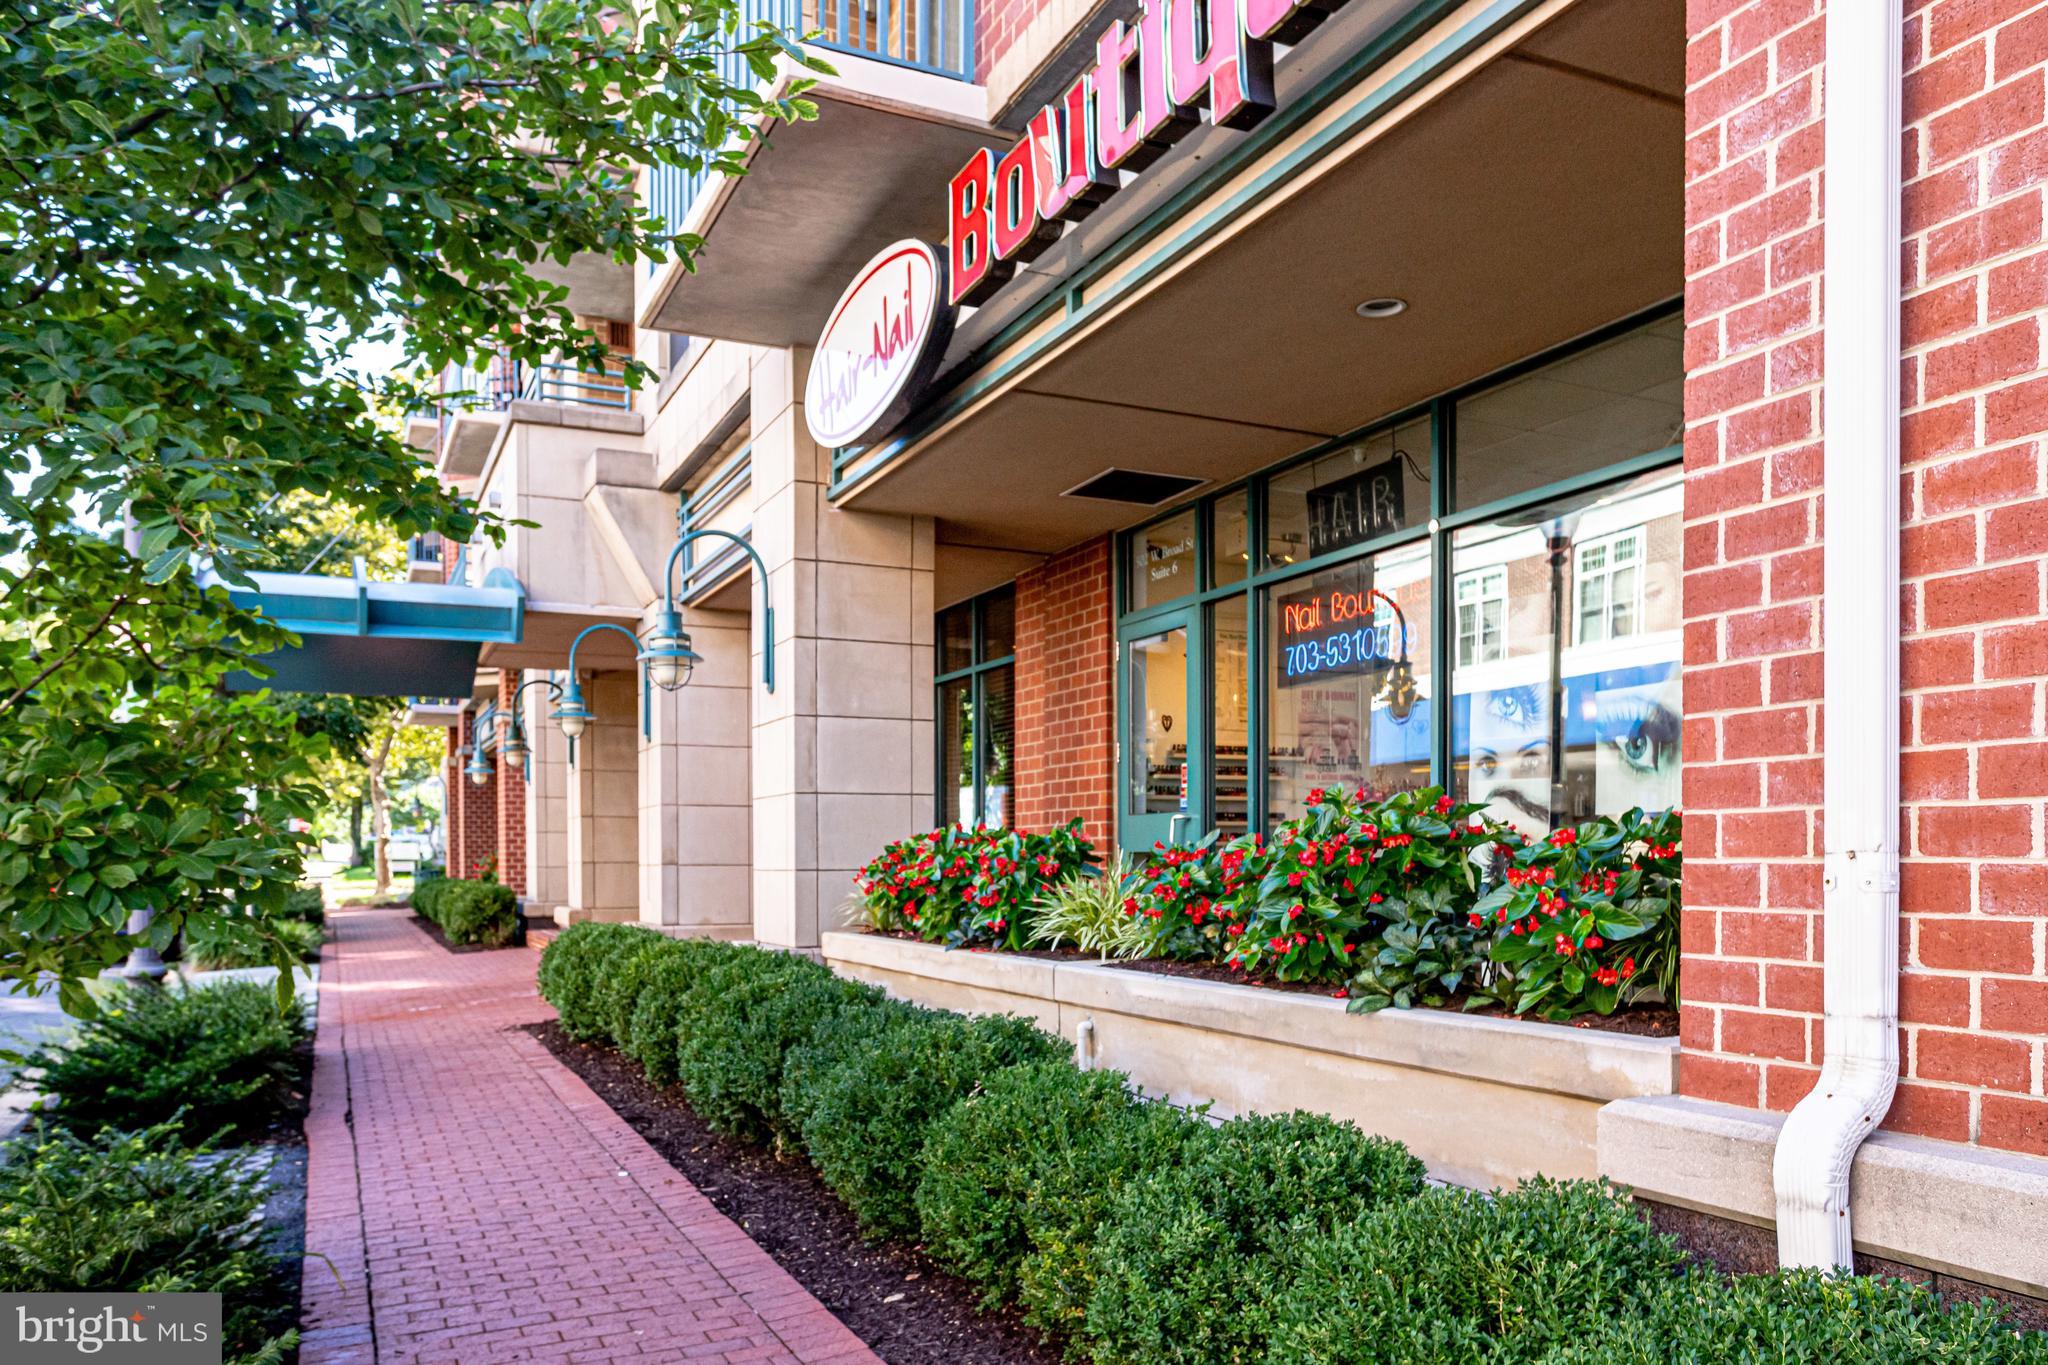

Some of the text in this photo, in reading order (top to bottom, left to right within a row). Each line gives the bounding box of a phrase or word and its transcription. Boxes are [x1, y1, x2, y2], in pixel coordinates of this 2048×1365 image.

[1151, 560, 1178, 581] Suite 6
[1285, 597, 1321, 634] Nail
